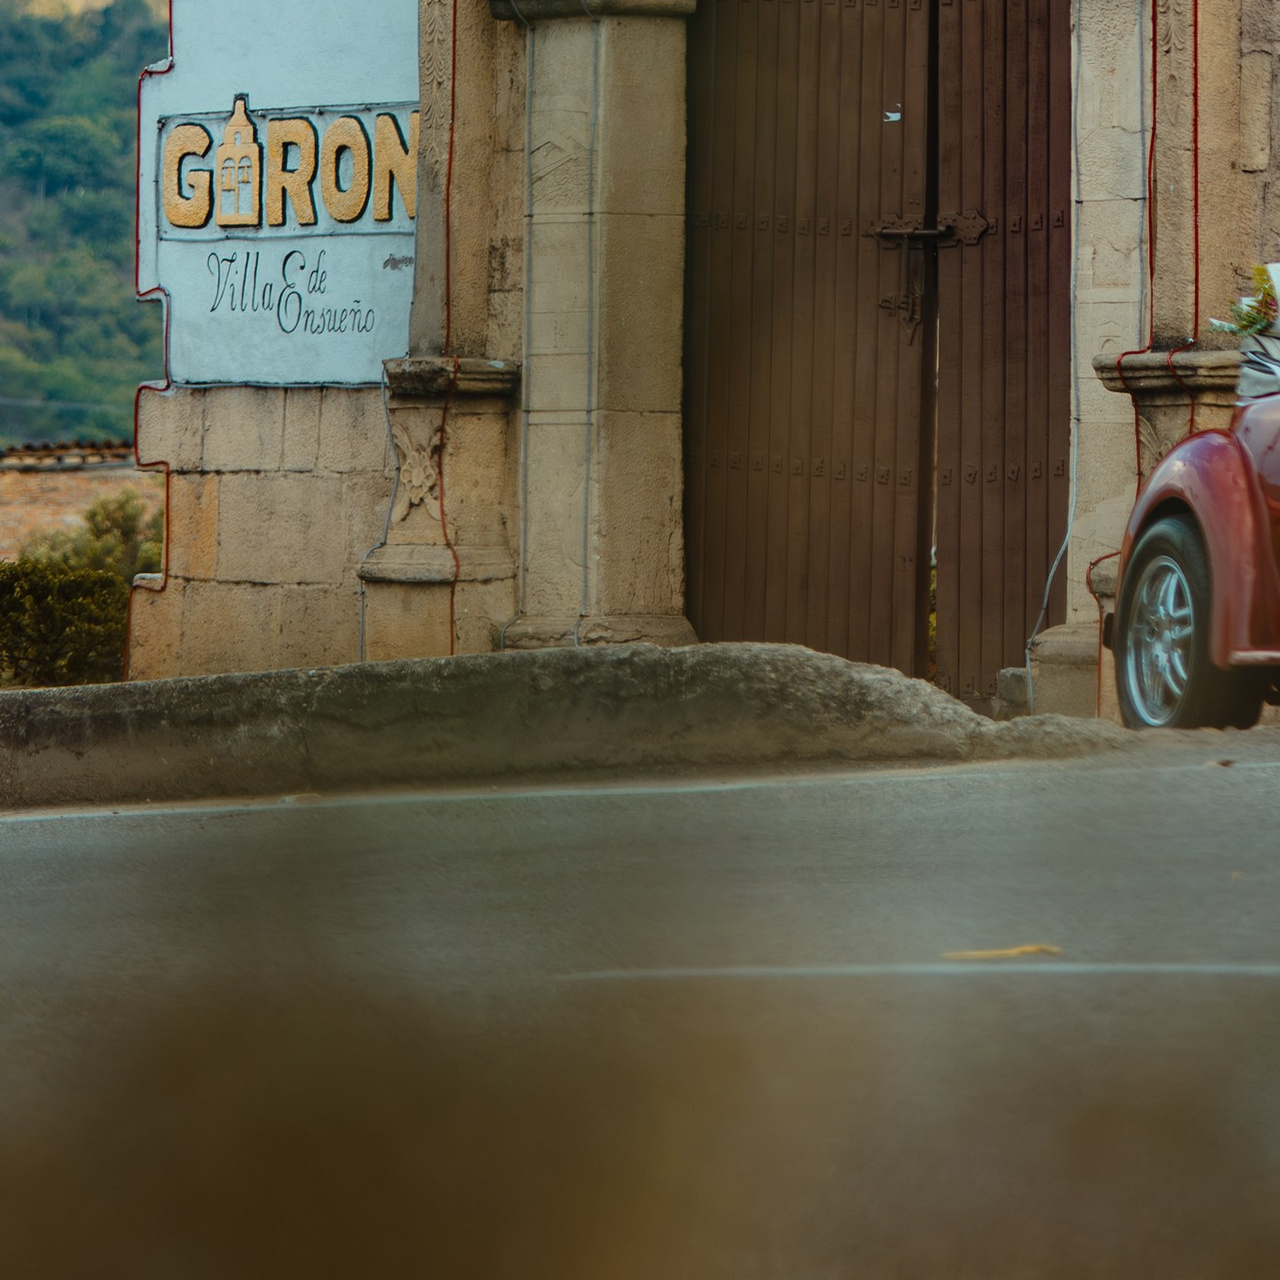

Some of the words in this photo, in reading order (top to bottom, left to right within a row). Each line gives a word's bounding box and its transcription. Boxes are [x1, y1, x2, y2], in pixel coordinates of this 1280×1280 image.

[207, 251, 274, 313] Villa
[307, 249, 328, 294] de
[277, 250, 375, 334] Ensueño
